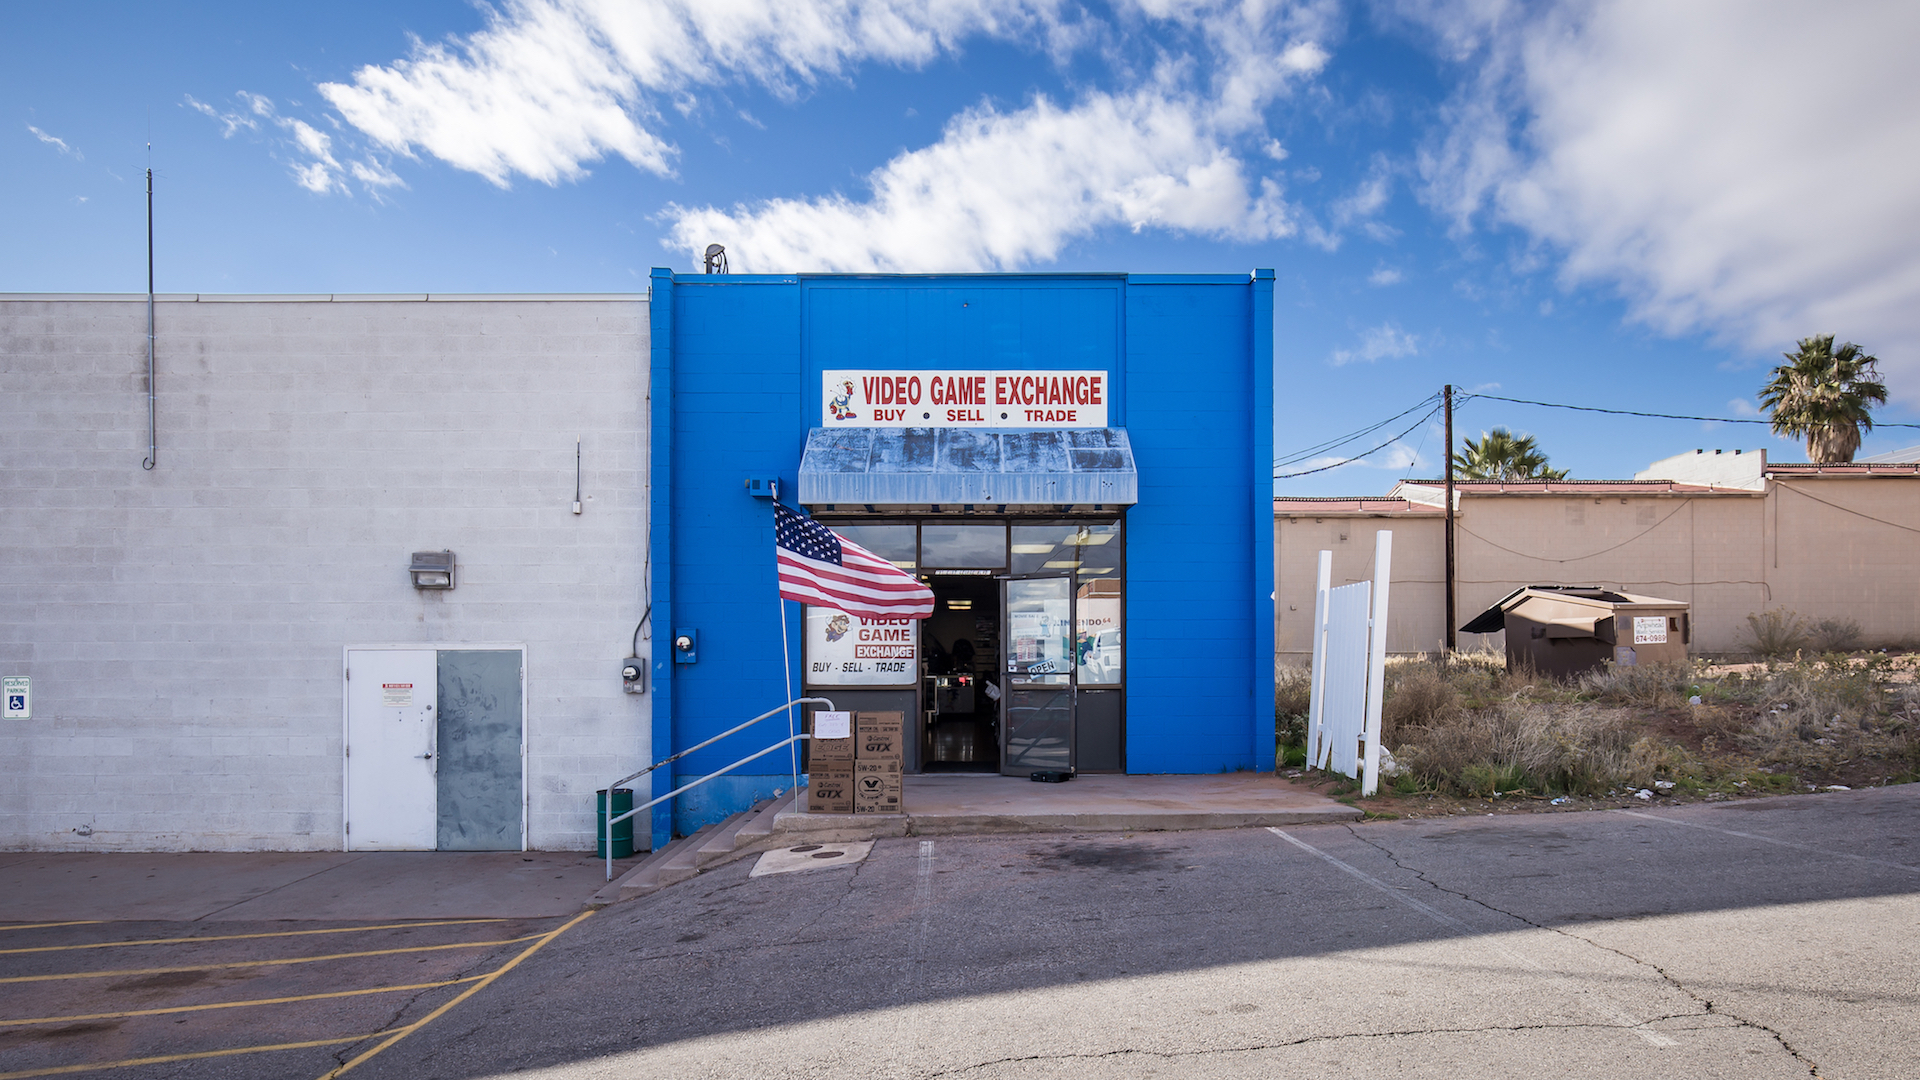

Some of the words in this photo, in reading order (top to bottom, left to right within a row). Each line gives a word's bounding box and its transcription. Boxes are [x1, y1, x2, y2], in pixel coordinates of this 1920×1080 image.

[862, 376, 922, 405] VIDEO
[930, 376, 986, 405] GAME
[995, 376, 1102, 405] EXCHANGE
[873, 409, 906, 421] BUY
[946, 409, 984, 422] SELL
[1024, 409, 1077, 422] TRADE
[858, 629, 911, 641] GAME
[857, 646, 913, 657] EXCHANGE
[812, 662, 832, 672] BUY
[842, 662, 863, 672] SELL
[875, 662, 906, 672] TRADE
[1030, 661, 1055, 675] OPEN
[815, 743, 850, 752] EDGE
[866, 742, 894, 752] GTX
[816, 790, 845, 799] GTX
